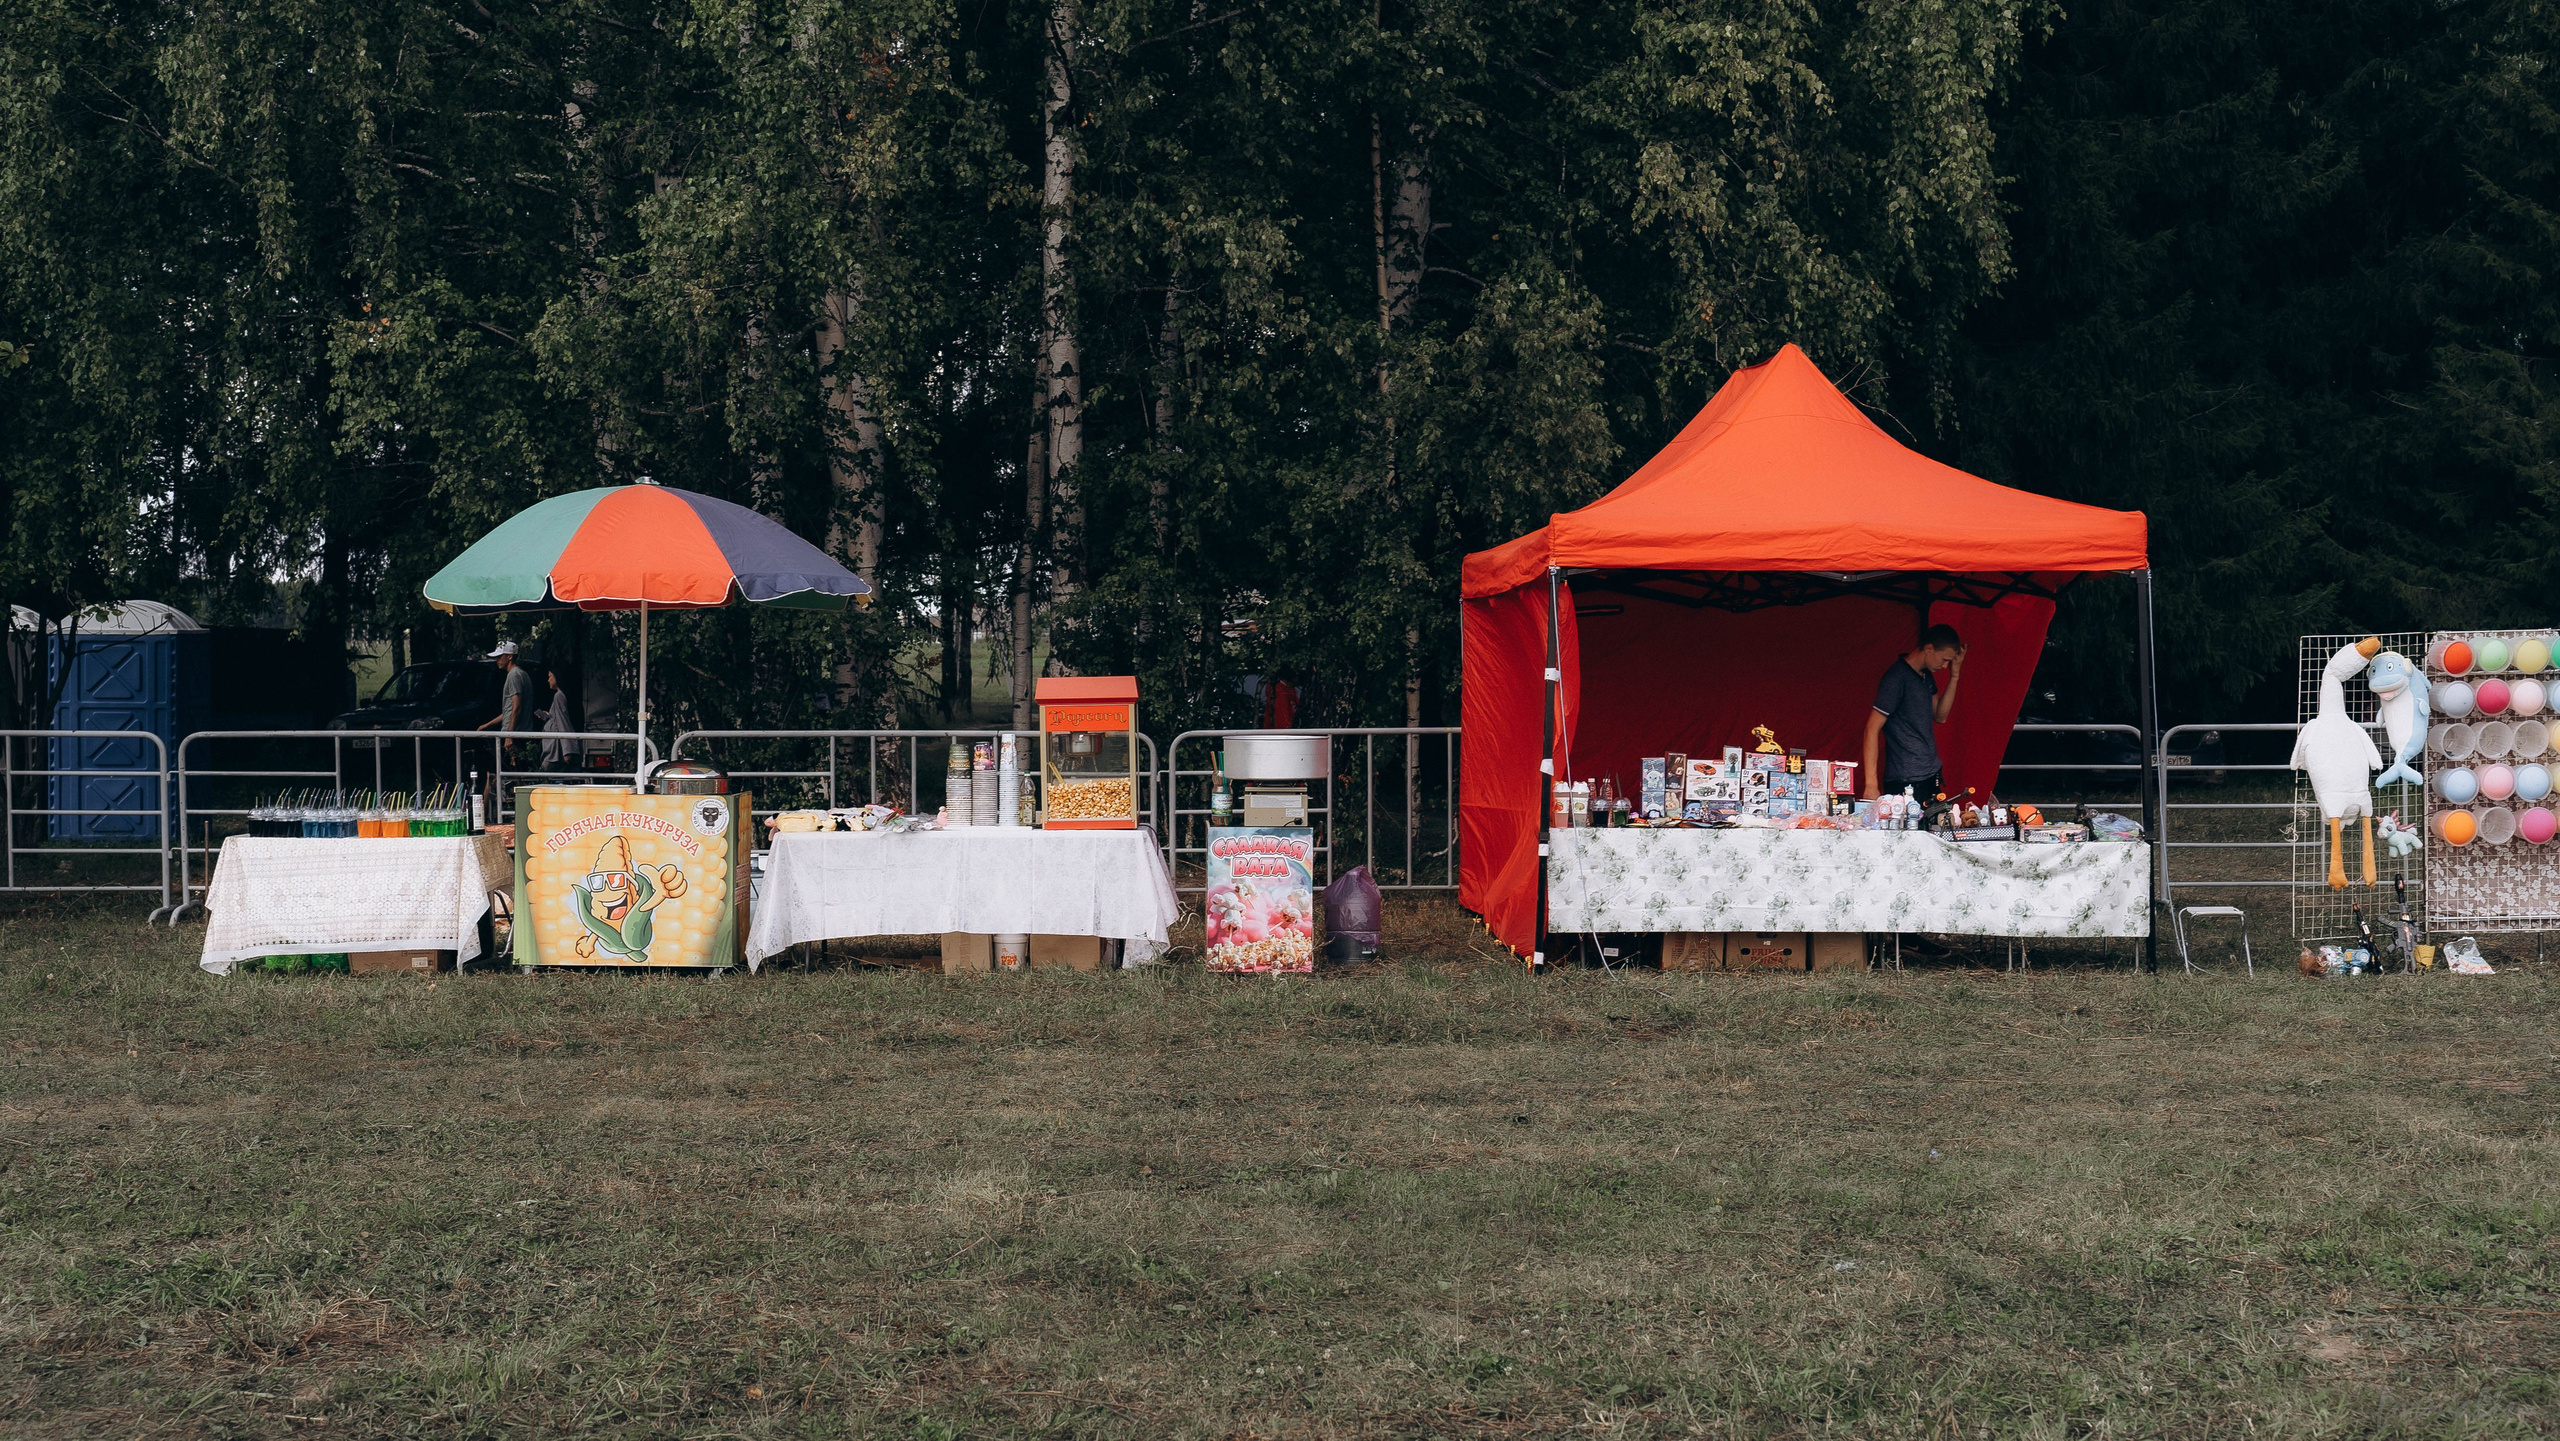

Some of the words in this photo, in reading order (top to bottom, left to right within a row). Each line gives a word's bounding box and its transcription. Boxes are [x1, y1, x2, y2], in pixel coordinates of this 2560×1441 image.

[1049, 710, 1126, 726] Popcorn
[546, 813, 615, 853] ГОРЯЧАЯ
[620, 812, 700, 857] КУКУРУЗА
[1212, 836, 1309, 861] СЛАДКАЯ
[1232, 856, 1289, 877] ВАТА
